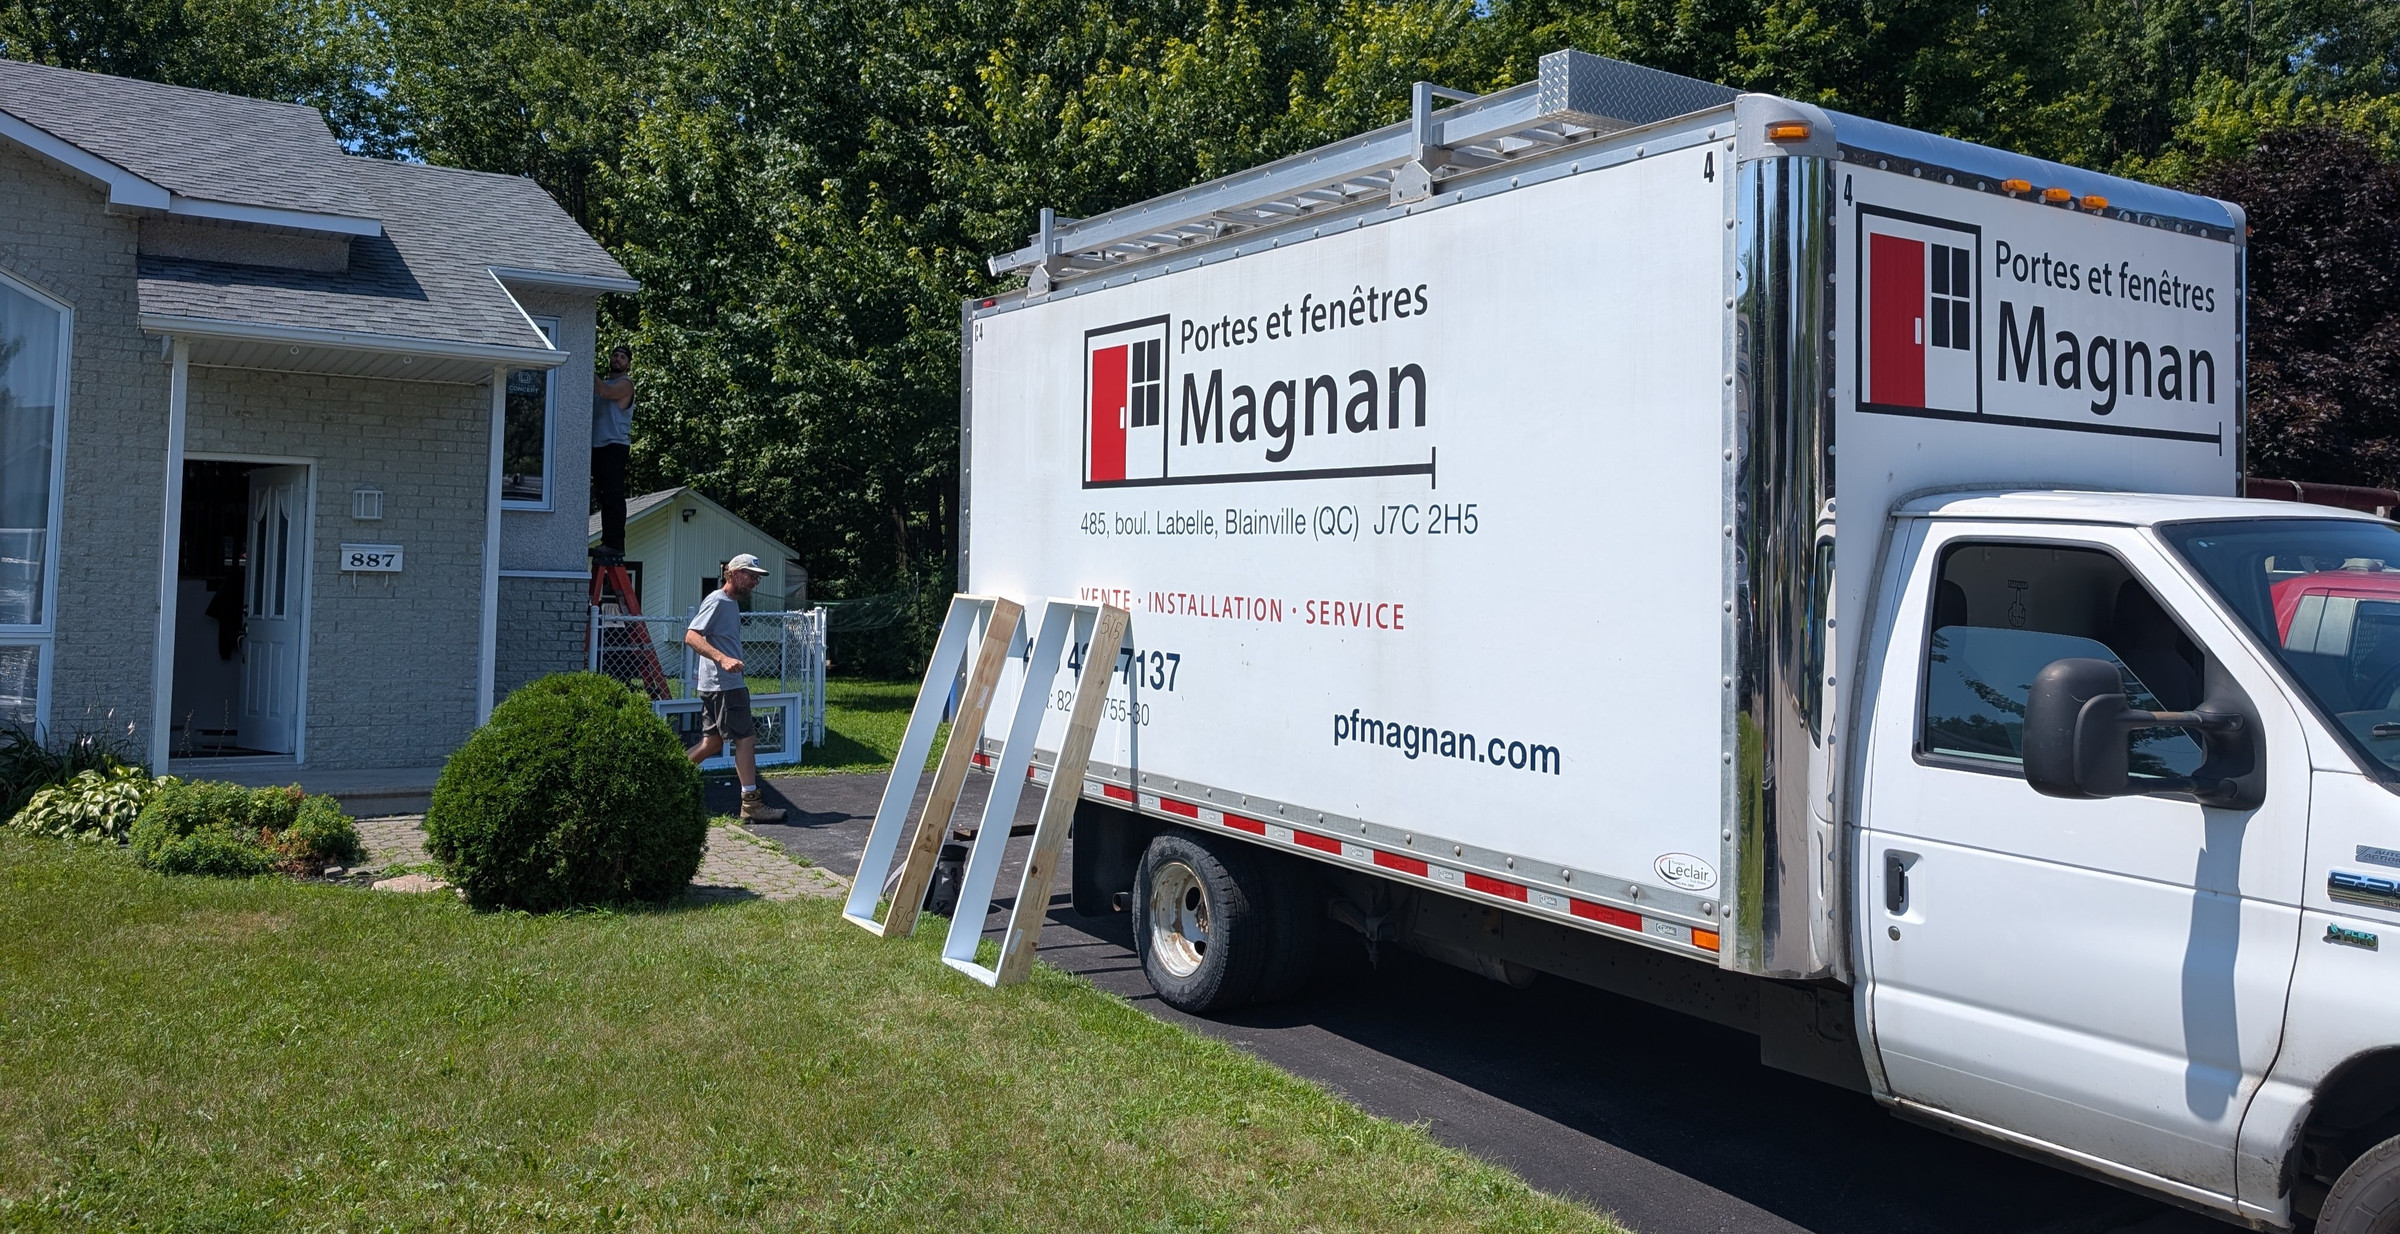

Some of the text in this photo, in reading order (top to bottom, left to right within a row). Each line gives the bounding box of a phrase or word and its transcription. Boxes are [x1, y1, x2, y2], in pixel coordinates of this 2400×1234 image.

[1703, 150, 1715, 184] 4
[1843, 173, 1854, 207] 4
[1995, 239, 2216, 313] Portes et fenêtres
[1181, 283, 1429, 355] Portes et fenêtres
[1996, 301, 2216, 416] Magnan
[1179, 362, 1427, 463] Magnan
[1080, 503, 1480, 542] 485, boul. Labelle, Blainville (QC) J7C 2H5
[350, 552, 395, 567] 887
[1081, 587, 1405, 631] VENTE INSTALLATION SERVICE
[1333, 708, 1562, 777] pfmagnan.com
[1667, 859, 1709, 881] Leclair
[2344, 929, 2375, 941] FLEX
